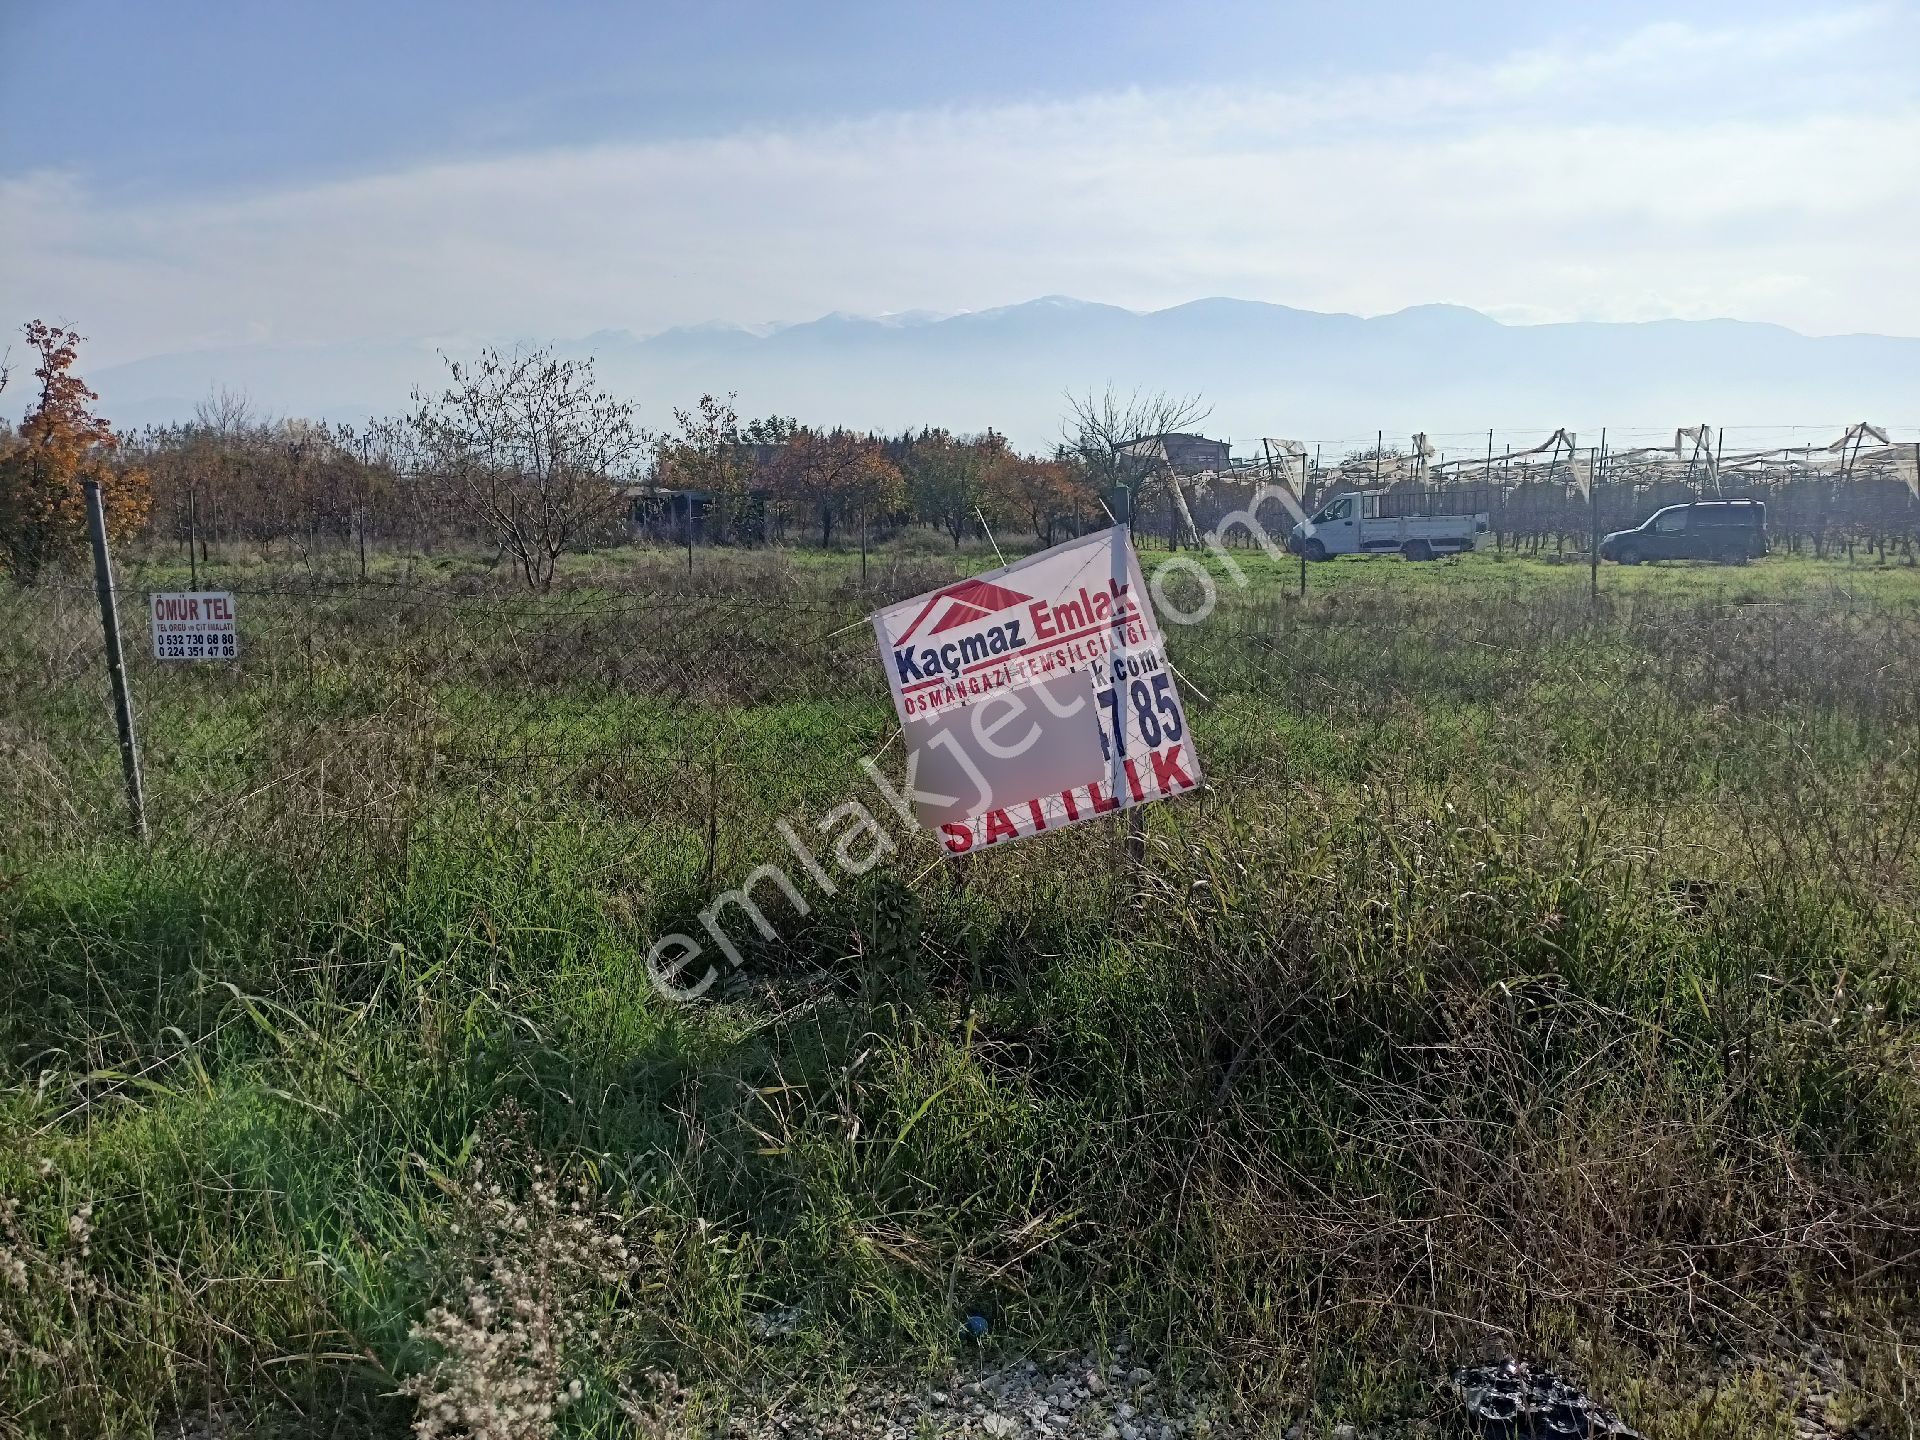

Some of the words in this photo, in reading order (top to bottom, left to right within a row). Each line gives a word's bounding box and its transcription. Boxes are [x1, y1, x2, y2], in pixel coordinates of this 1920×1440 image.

[155, 594, 199, 621] ÖMÜR
[203, 598, 233, 620] TEL
[157, 623, 168, 632] TEL
[158, 634, 164, 645] 0
[166, 634, 184, 645] 532
[186, 634, 204, 645] 730
[207, 634, 219, 645] 68
[221, 633, 234, 645] 80
[894, 620, 1026, 684] Kaçmaz
[1028, 577, 1137, 640] Emlak
[159, 646, 165, 657] 0
[167, 646, 185, 657] 224
[188, 646, 204, 657] 351
[207, 646, 219, 657] 47
[222, 645, 235, 657] 06
[904, 662, 1012, 715] OSMANGAZİ
[1016, 619, 1147, 679] TEMSİLCİLİĞİ
[1130, 672, 1183, 748] 85
